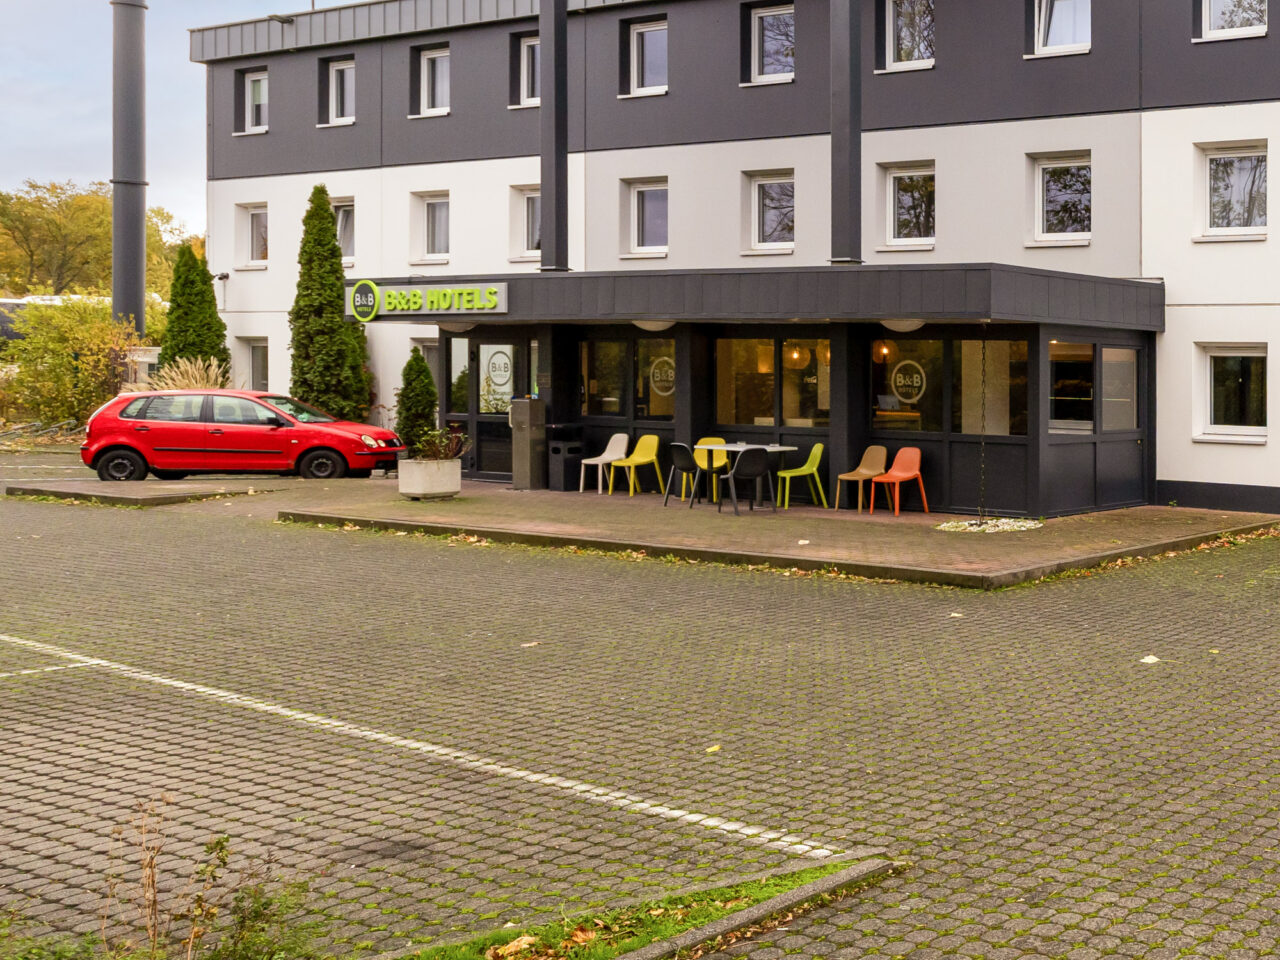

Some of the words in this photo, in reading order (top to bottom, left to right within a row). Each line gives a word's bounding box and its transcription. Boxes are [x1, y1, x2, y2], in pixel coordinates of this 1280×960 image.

[354, 293, 375, 306] B&B
[384, 289, 422, 311] B&B
[426, 287, 498, 311] HOTELS
[896, 373, 922, 387] B&B
